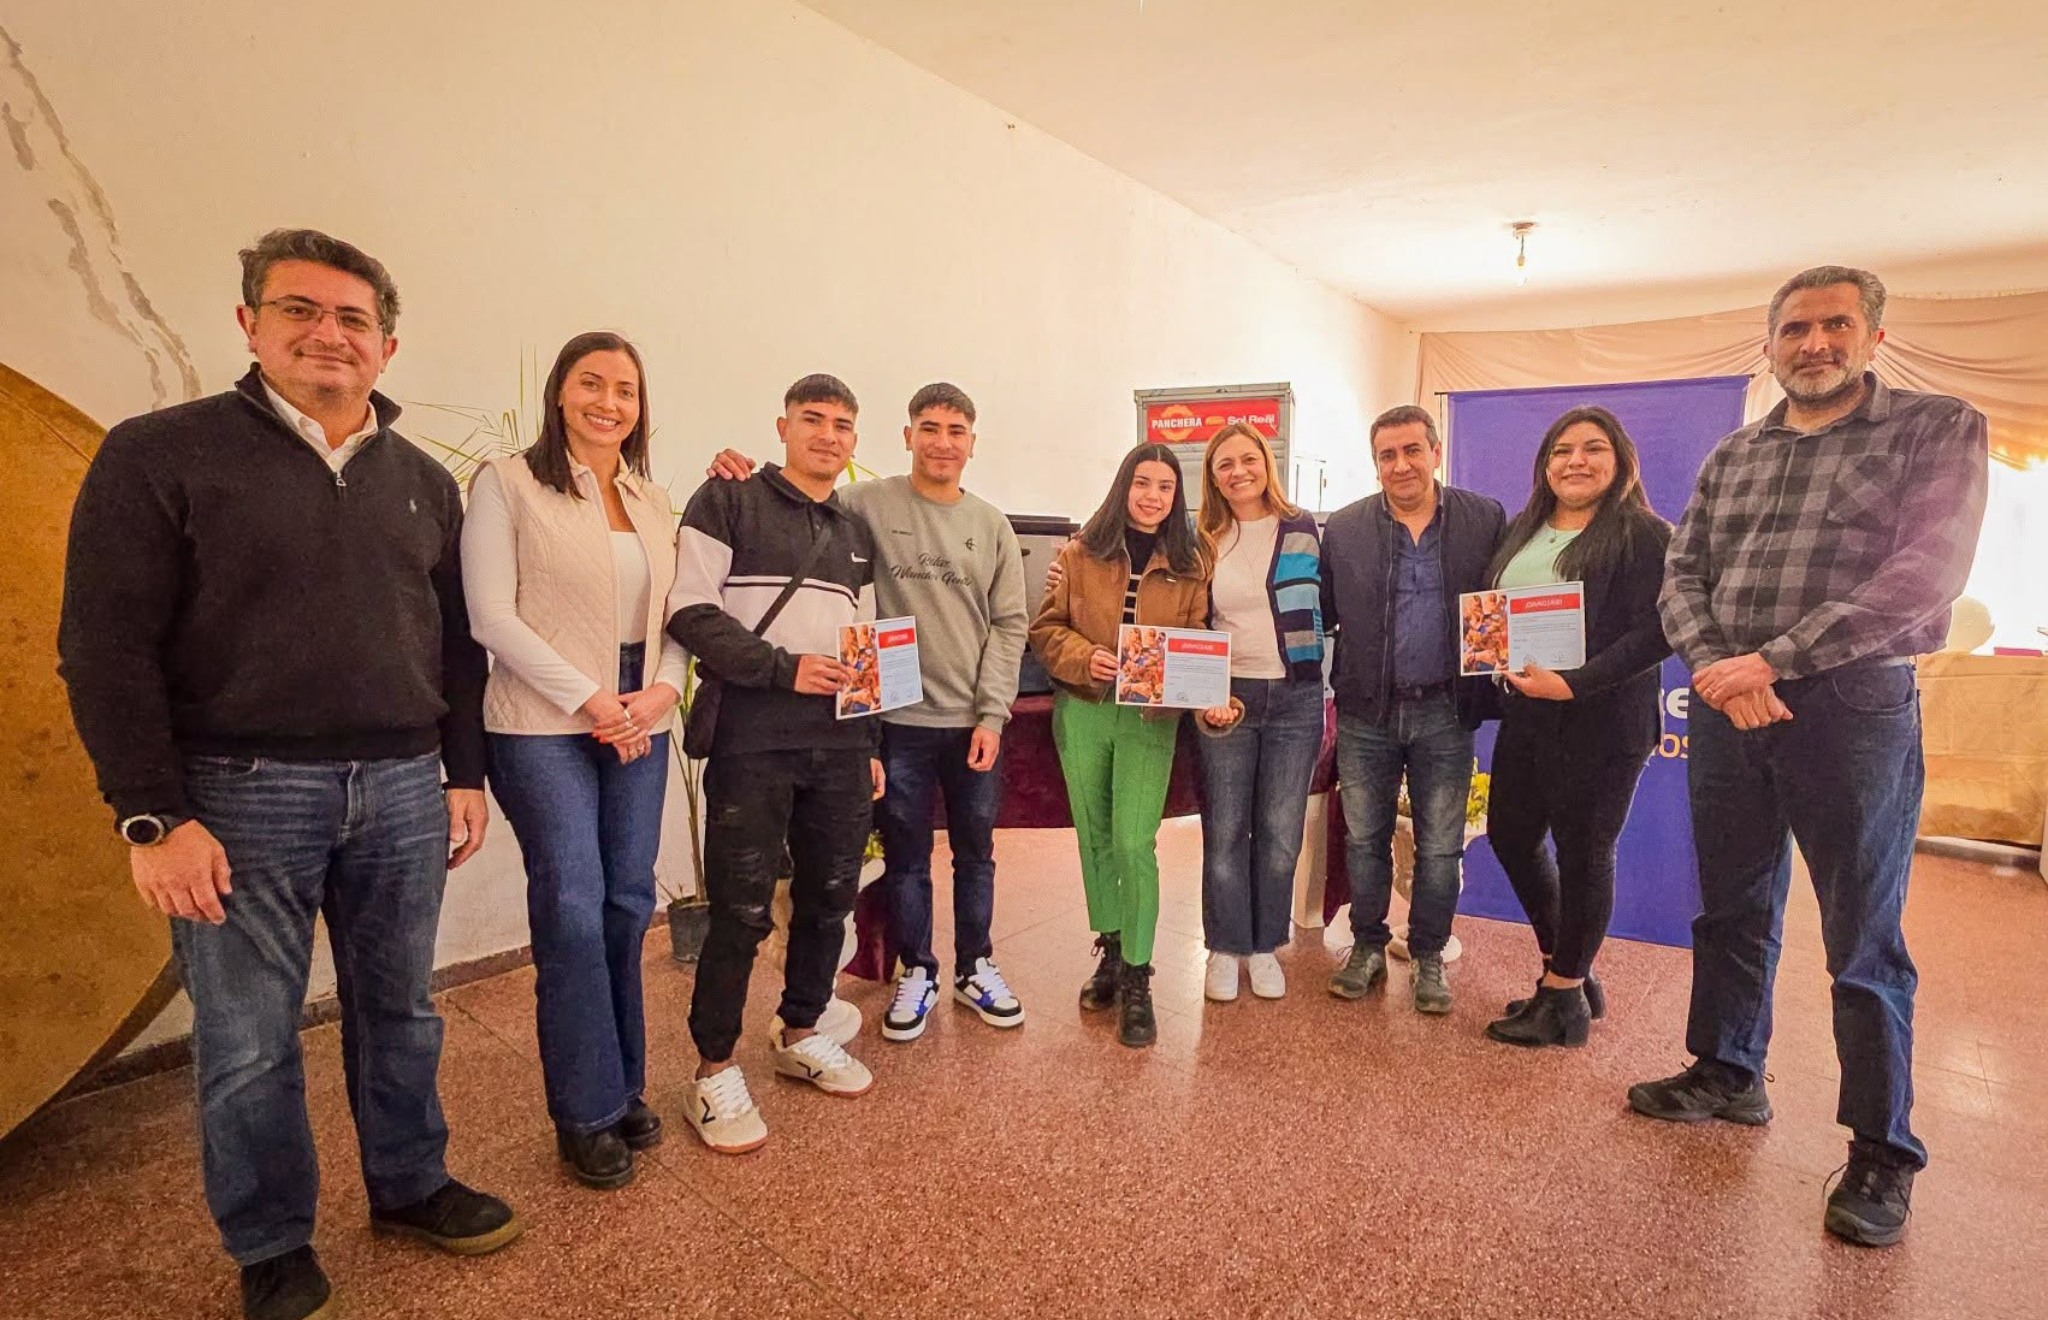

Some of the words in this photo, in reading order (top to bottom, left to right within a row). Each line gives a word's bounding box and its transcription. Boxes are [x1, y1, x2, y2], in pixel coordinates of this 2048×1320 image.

[1152, 417, 1202, 429] PANCHERA
[1227, 415, 1246, 425] Sol
[1248, 414, 1275, 424] Real
